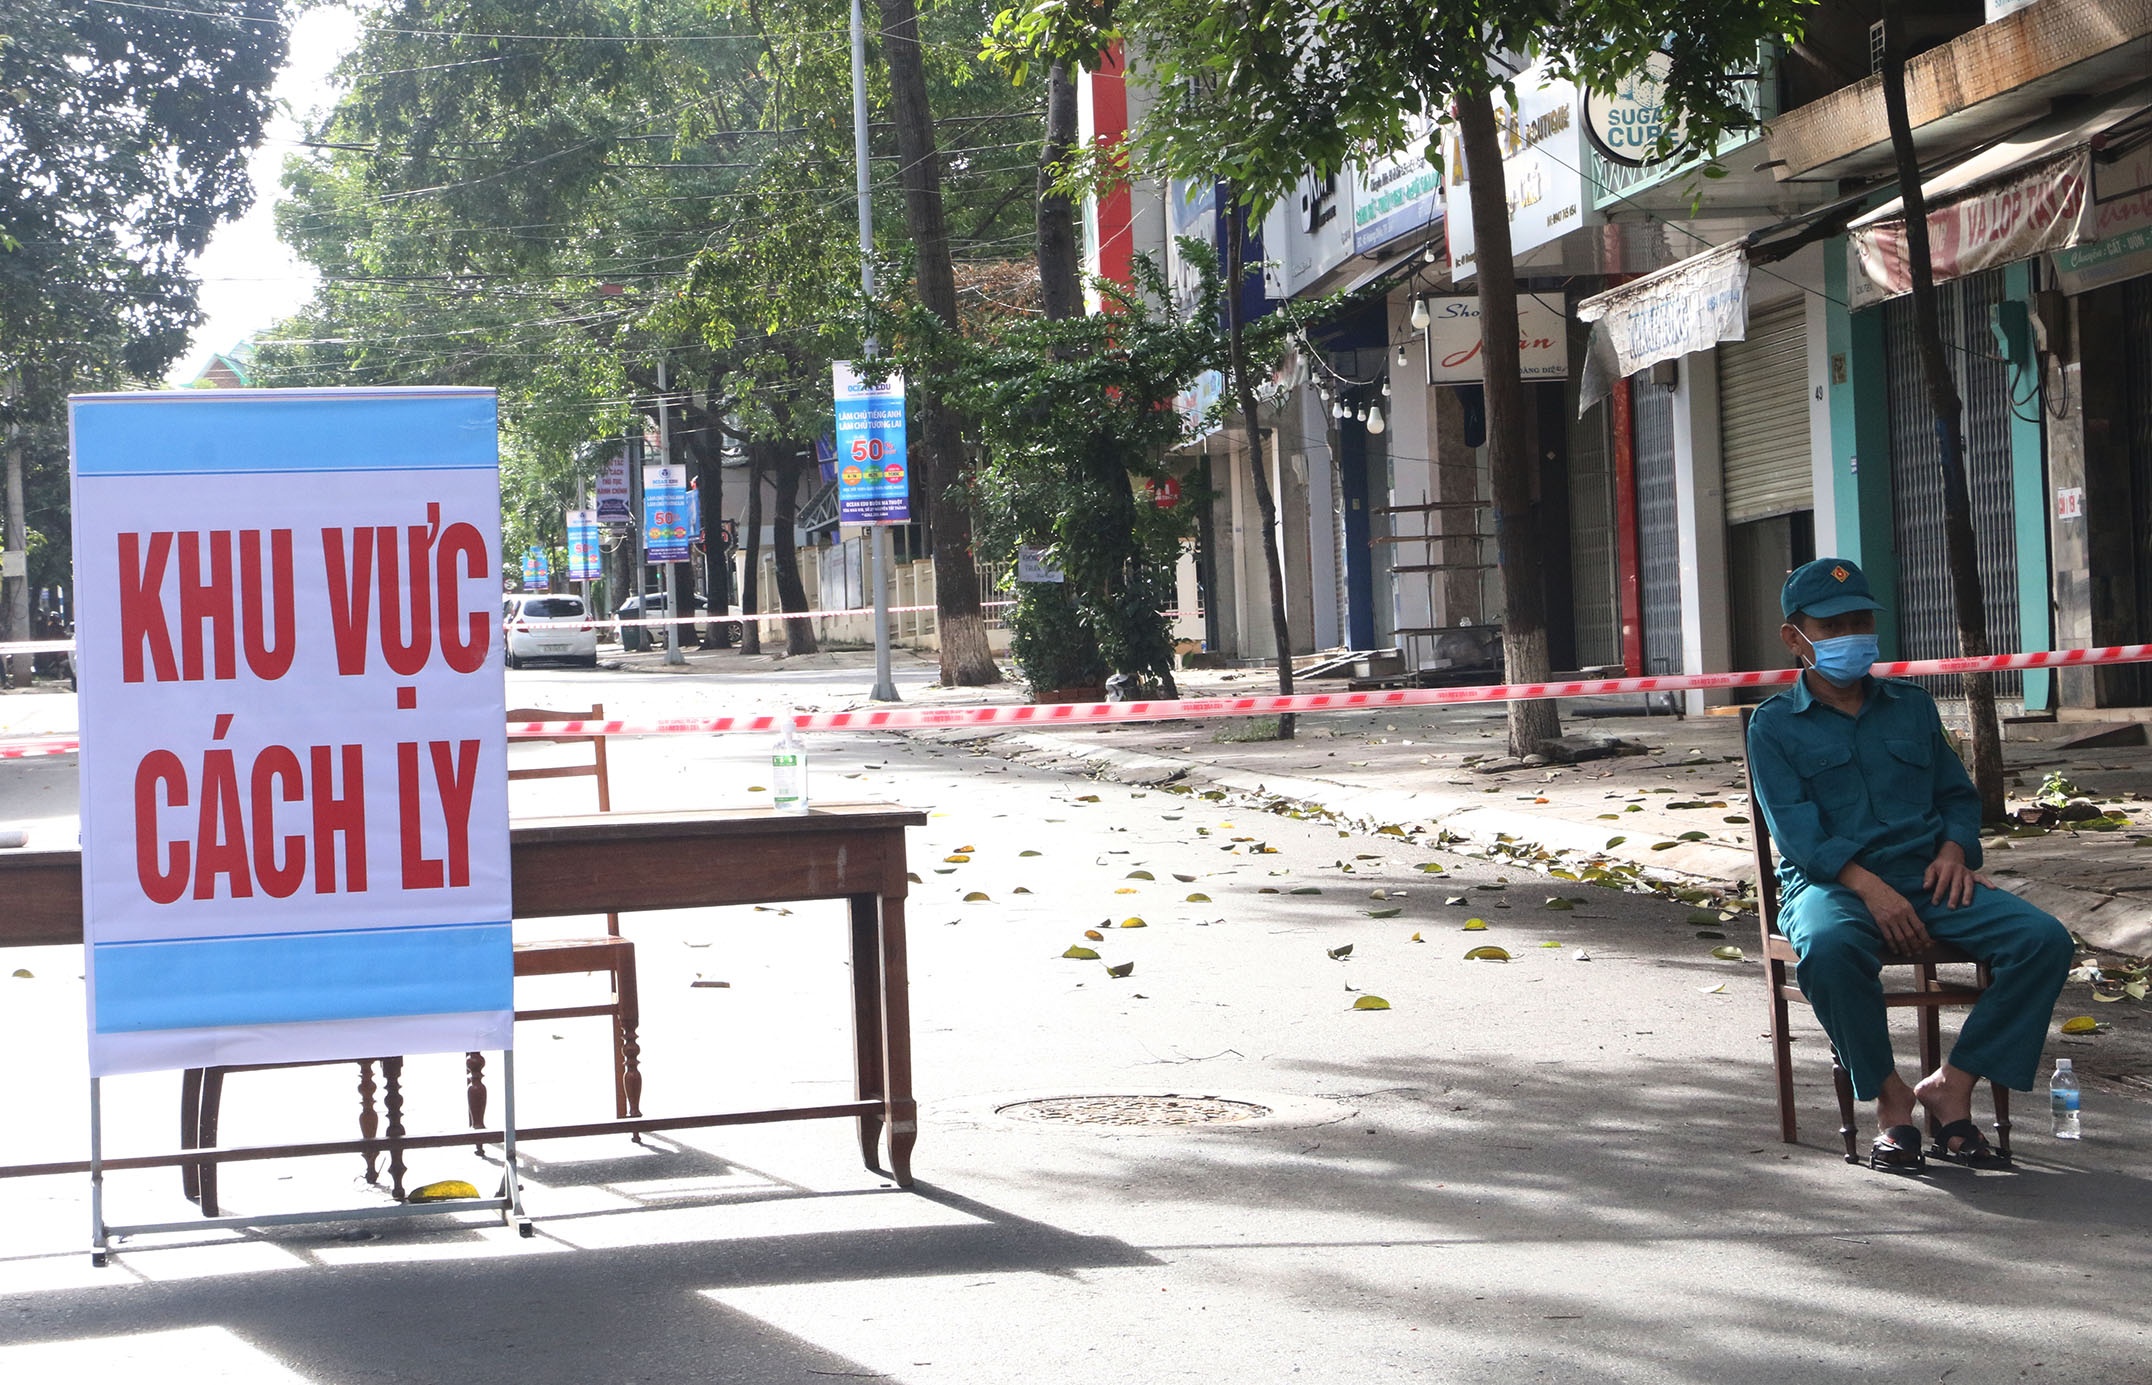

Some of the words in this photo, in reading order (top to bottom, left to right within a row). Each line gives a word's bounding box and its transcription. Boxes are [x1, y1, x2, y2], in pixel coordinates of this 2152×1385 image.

[1608, 108, 1672, 126] SUGA
[1525, 103, 1571, 149] BOUTIQUE
[1438, 303, 1481, 319] Sho
[875, 383, 891, 391] EDU
[1815, 385, 1824, 401] 49
[887, 410, 902, 418] ANH
[117, 528, 296, 683] KHU
[321, 502, 490, 710] VỰC
[134, 713, 368, 905] CÁCH
[397, 739, 481, 891] LY
